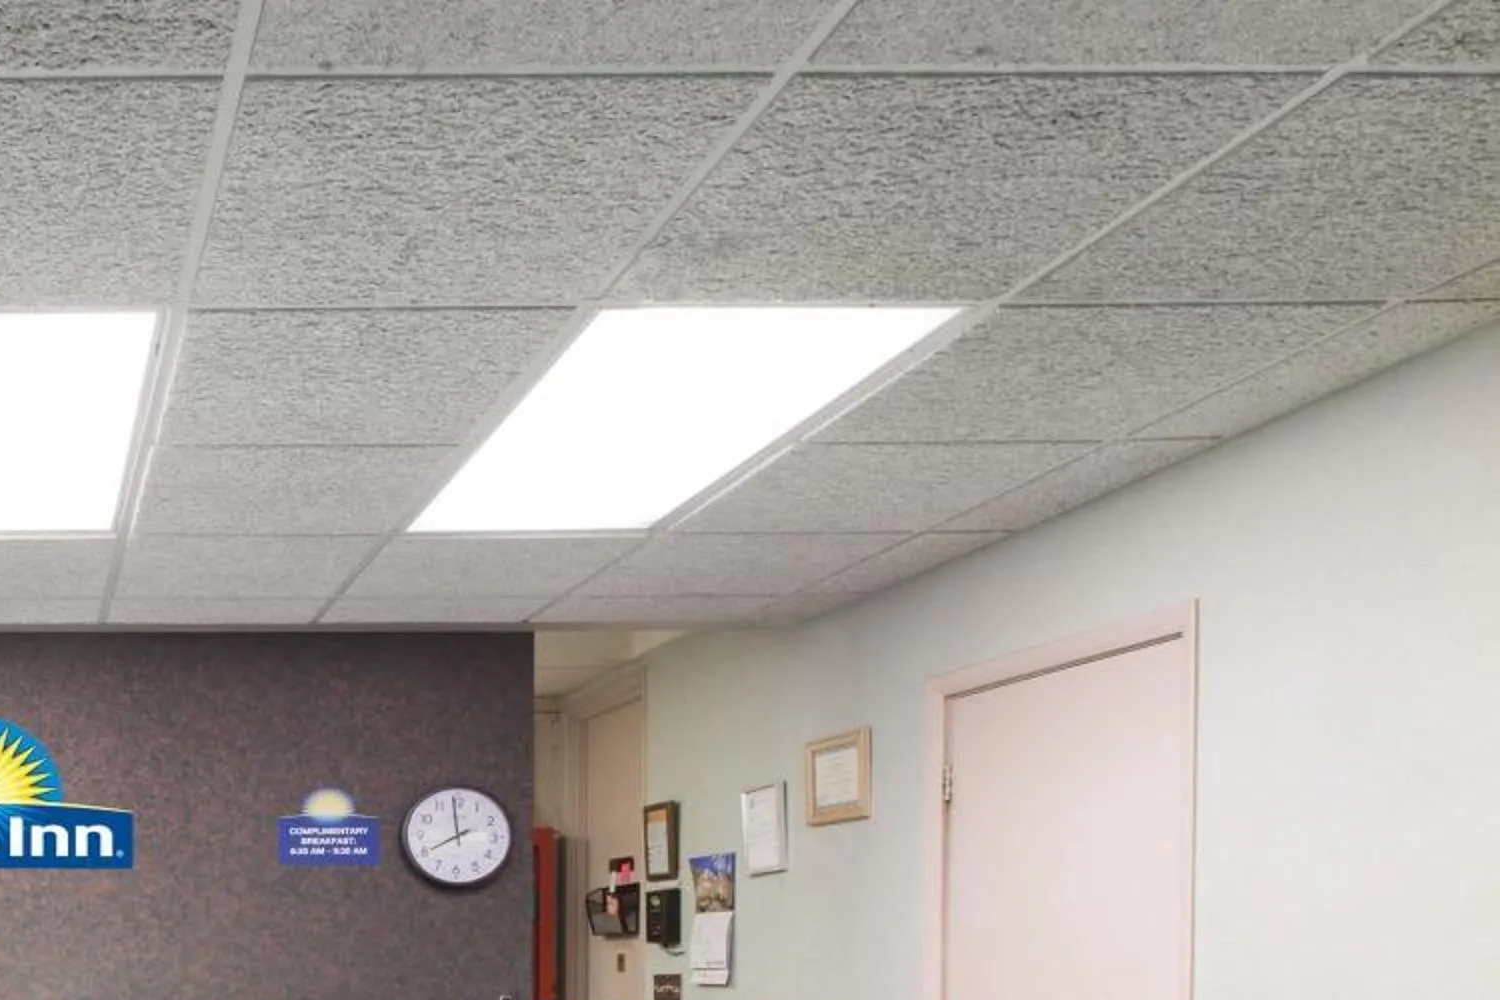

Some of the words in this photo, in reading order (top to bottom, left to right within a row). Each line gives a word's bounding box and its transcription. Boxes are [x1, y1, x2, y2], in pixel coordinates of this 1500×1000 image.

[487, 815, 495, 827] 2
[8, 815, 114, 857] Inn
[289, 827, 368, 836] COMPLIMENTARY
[310, 847, 325, 855] AM
